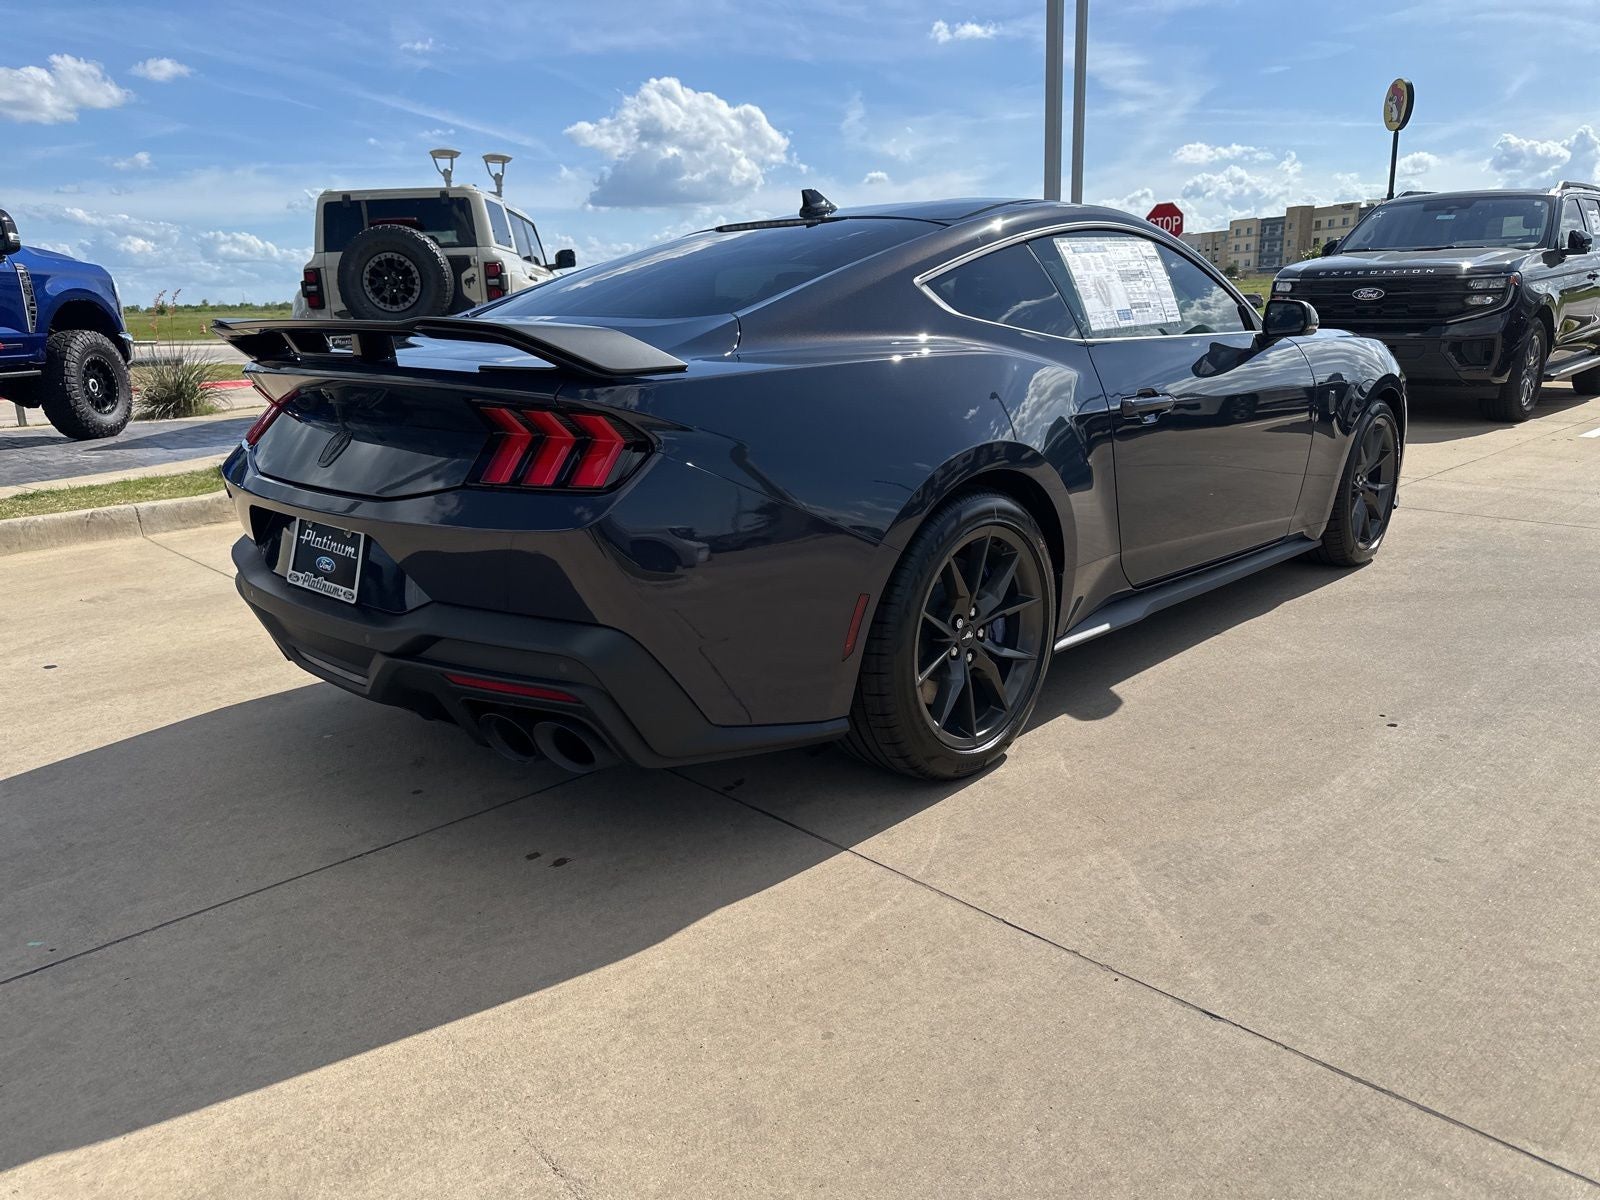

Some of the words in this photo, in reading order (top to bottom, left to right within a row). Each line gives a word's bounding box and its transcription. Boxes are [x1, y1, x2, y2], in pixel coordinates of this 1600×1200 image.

[1357, 288, 1379, 299] Ford
[300, 529, 357, 559] Platinum
[302, 573, 342, 597] Platinum
